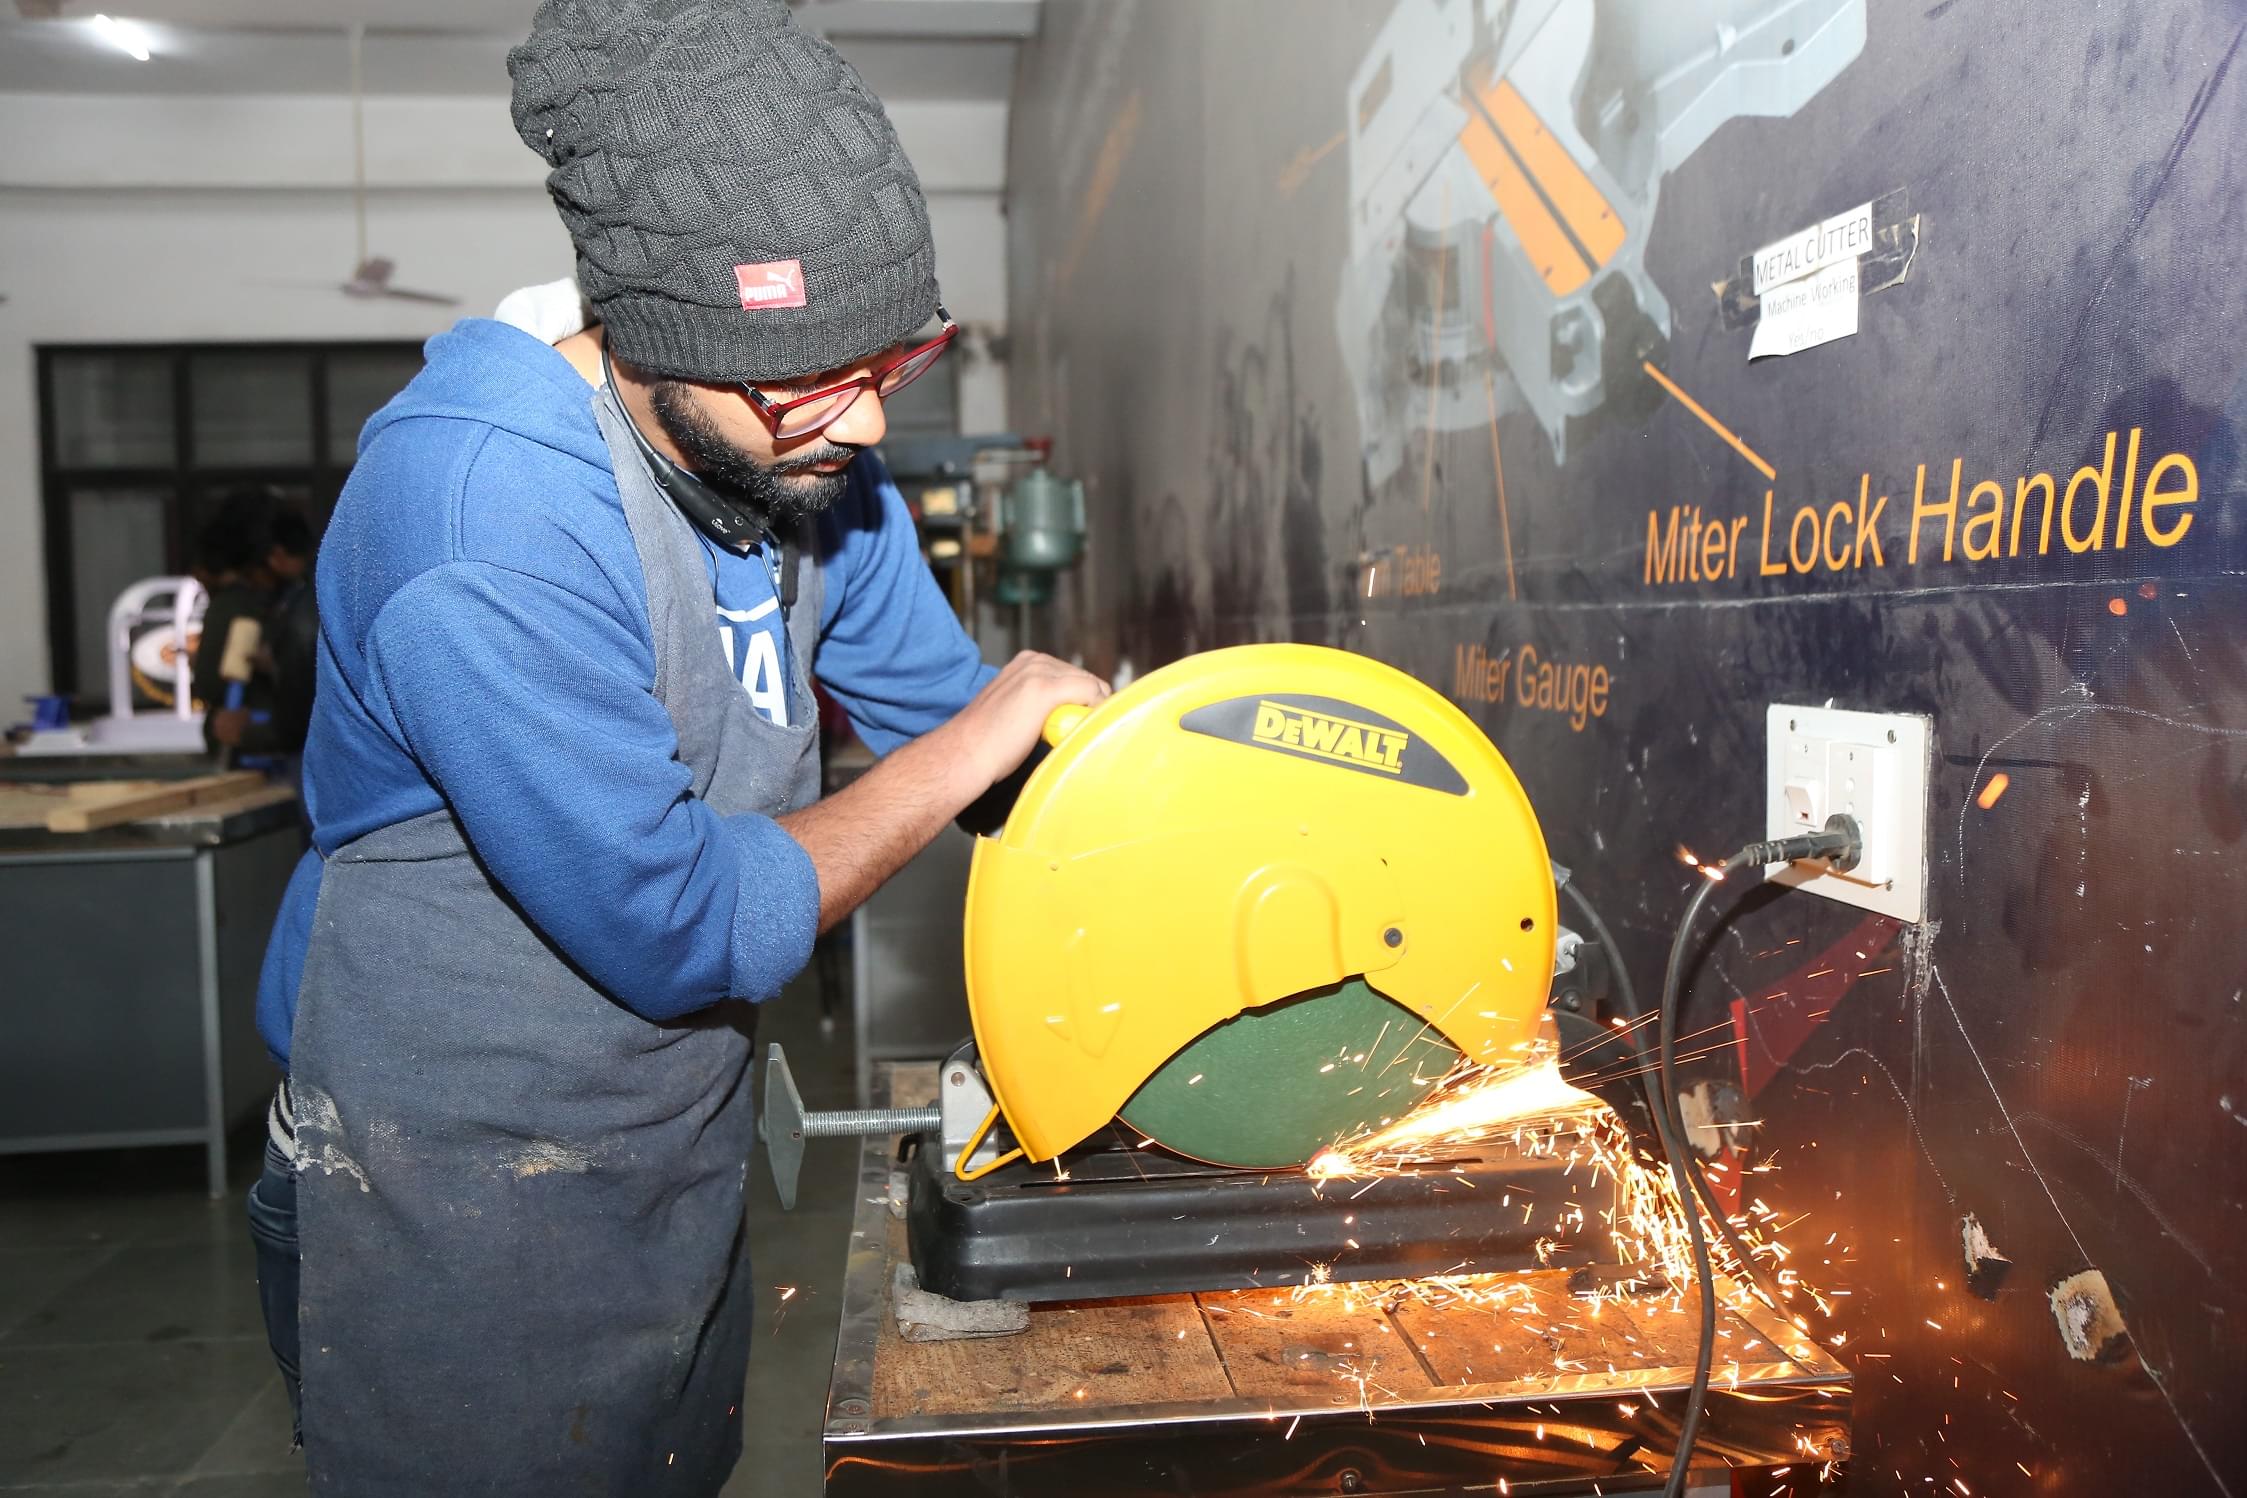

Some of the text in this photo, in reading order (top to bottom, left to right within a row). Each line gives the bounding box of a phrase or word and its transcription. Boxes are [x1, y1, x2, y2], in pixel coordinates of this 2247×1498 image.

[1756, 216, 1869, 285] METAL CUTTER
[1768, 275, 1855, 318] Machine Working
[1644, 427, 2201, 584] Miter Lock Handle
[1455, 642, 1610, 733] Miter Gauge
